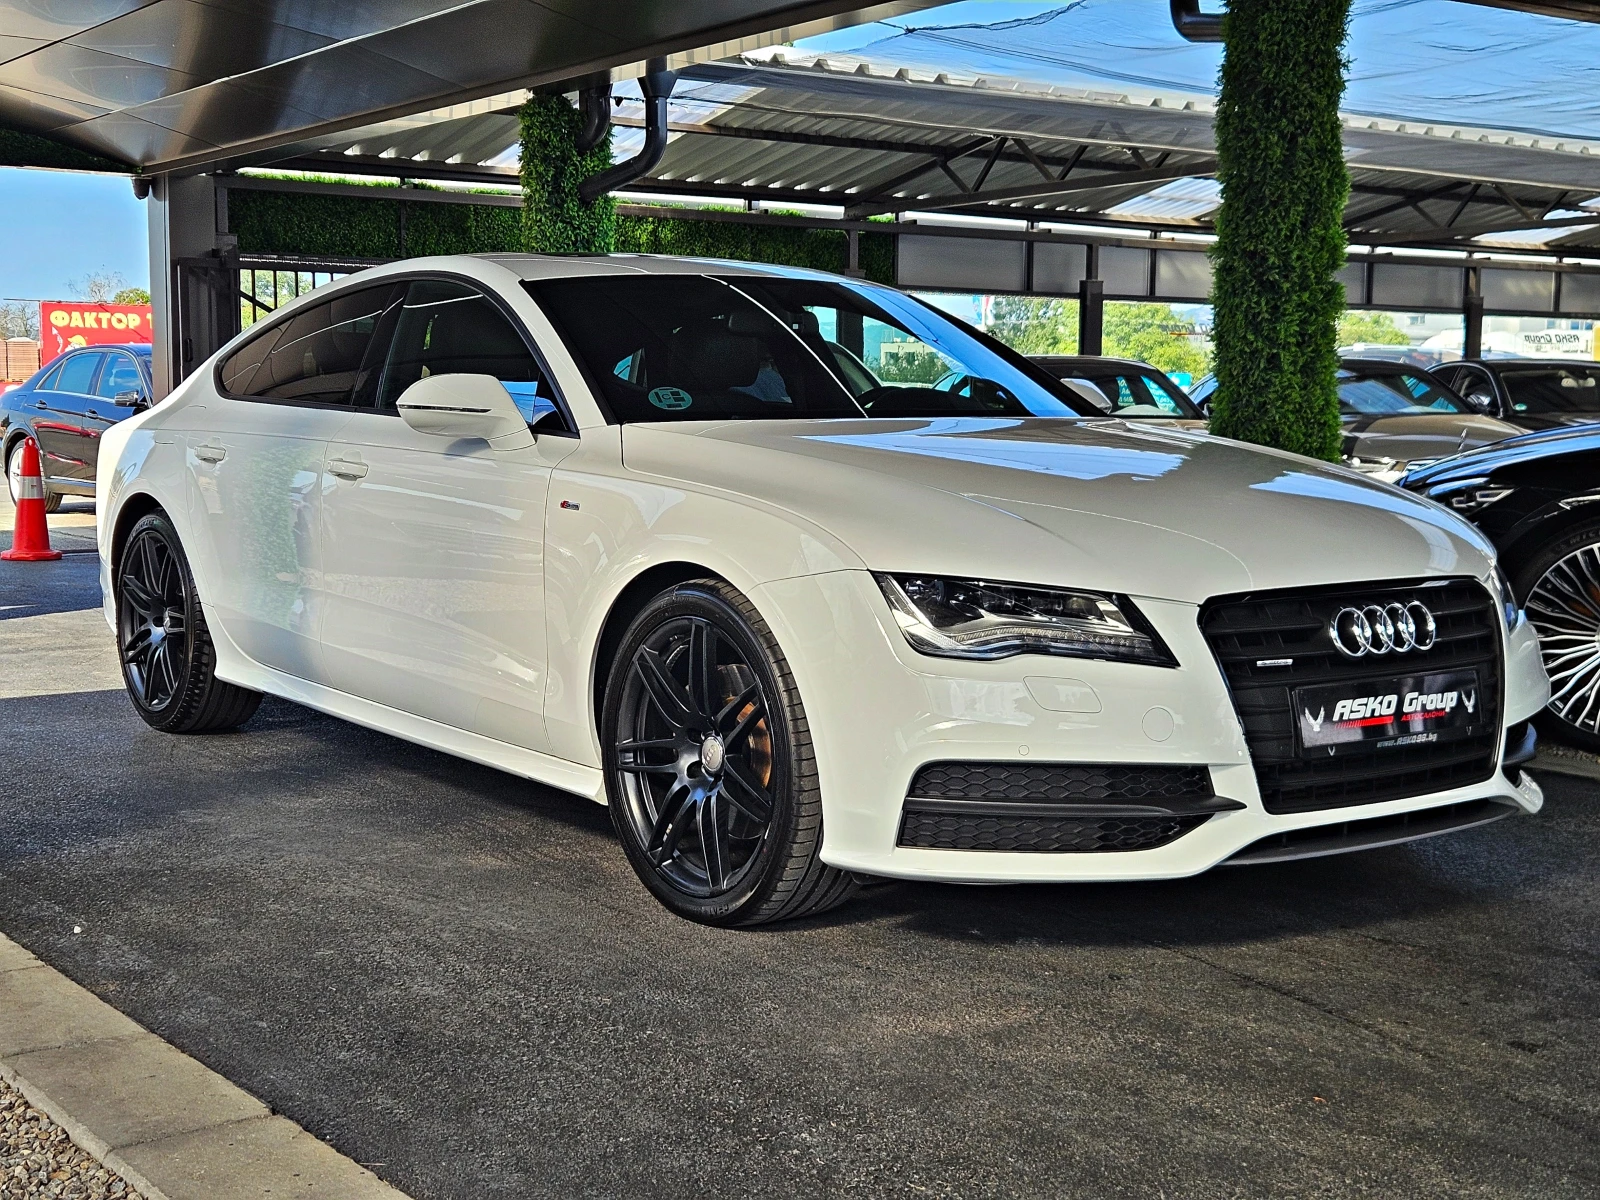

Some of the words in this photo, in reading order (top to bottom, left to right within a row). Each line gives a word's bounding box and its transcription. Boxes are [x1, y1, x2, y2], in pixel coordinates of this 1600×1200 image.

[50, 310, 140, 329] ФАКТОР
[1332, 694, 1398, 722] ASKO
[1402, 691, 1459, 713] Group
